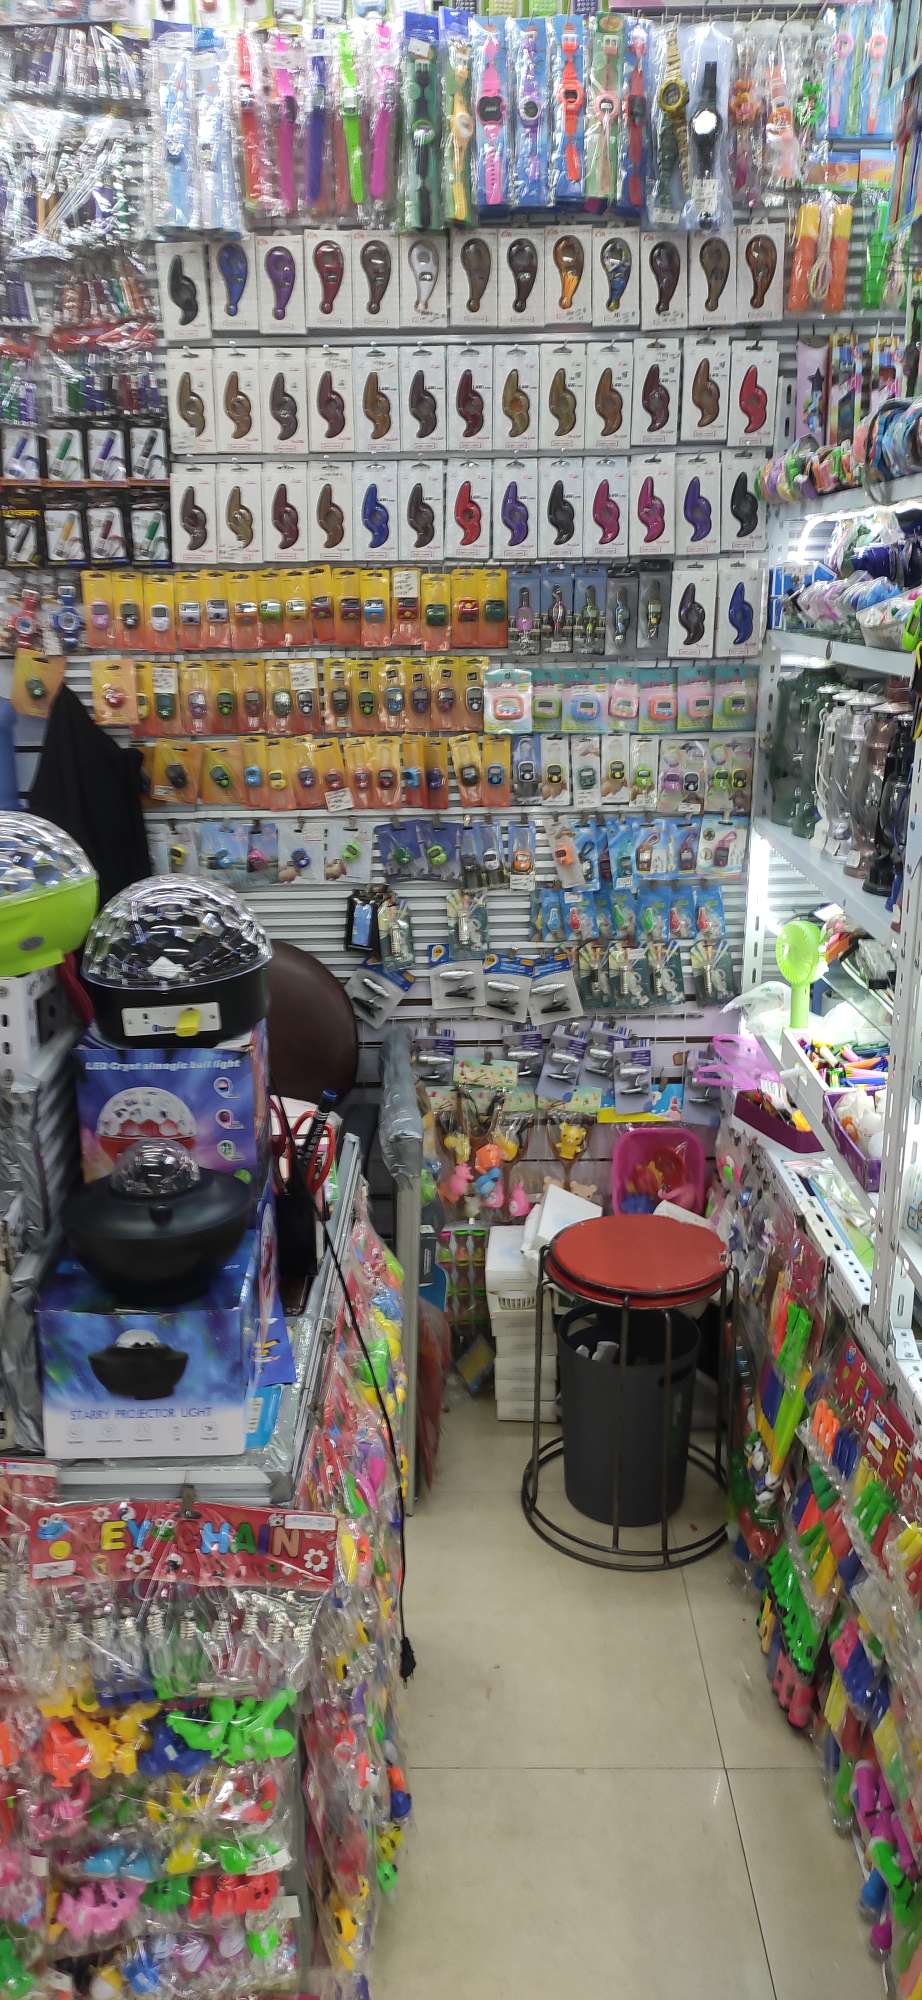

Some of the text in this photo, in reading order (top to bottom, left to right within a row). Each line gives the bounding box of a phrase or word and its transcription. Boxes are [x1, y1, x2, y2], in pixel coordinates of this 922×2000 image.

[70, 1407, 212, 1420] STARRY PROJECTOR LIGHT
[77, 1519, 301, 1558] KEY CHAIN
